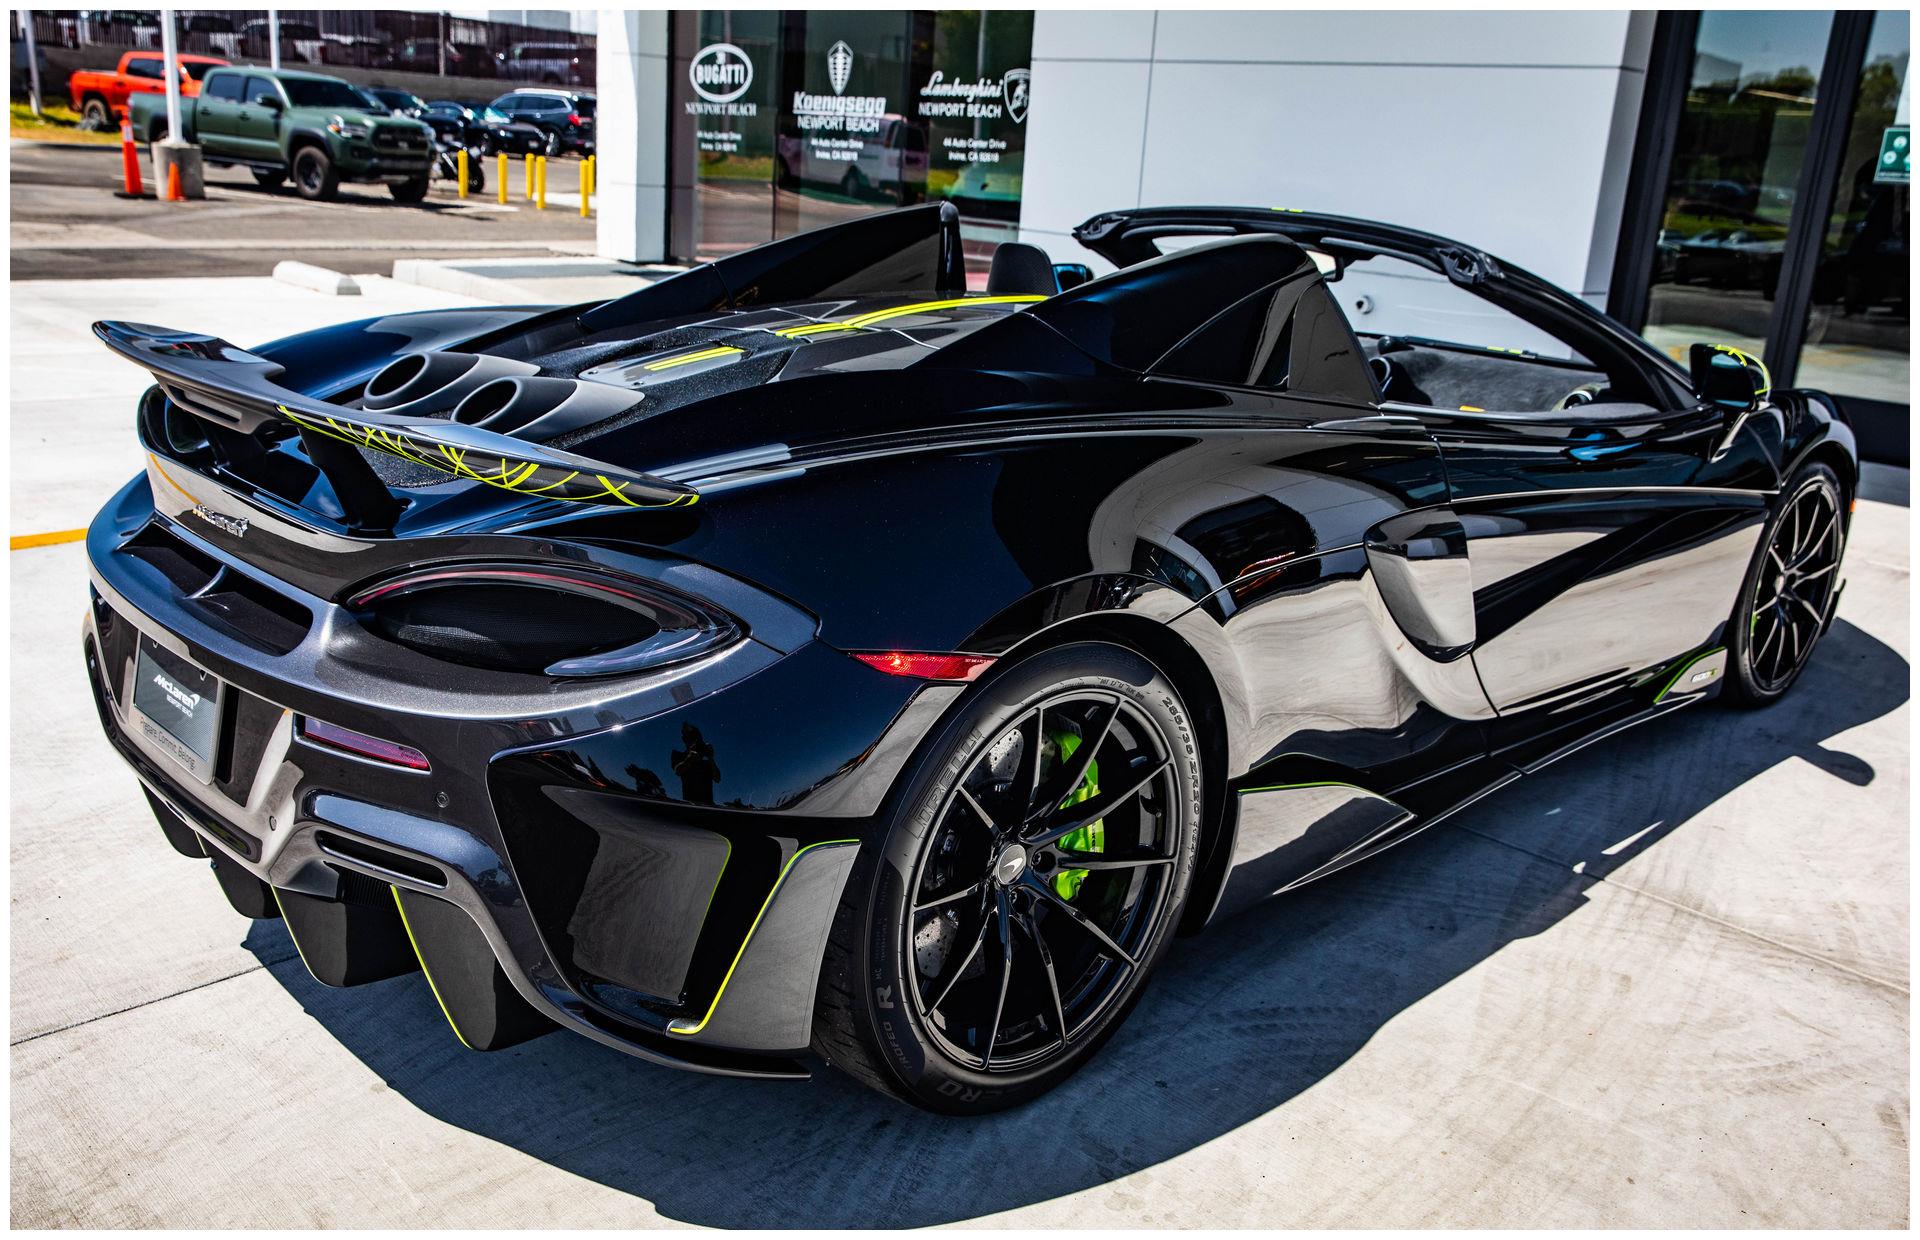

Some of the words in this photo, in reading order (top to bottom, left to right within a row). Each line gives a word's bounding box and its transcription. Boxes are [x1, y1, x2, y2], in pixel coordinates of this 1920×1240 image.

[696, 64, 745, 84] BUGATTI
[920, 71, 1004, 102] Lamborghini
[685, 102, 727, 115] NEWPORT
[728, 103, 757, 116] BEACH
[793, 91, 886, 118] Koenigsegg
[918, 102, 966, 117] NEWPORT
[967, 103, 1002, 118] BEACH
[797, 115, 845, 130] NEWPORT
[845, 117, 880, 132] BEACH
[953, 137, 967, 148] Auto
[967, 138, 988, 149] Center
[988, 138, 1007, 150] Drive
[967, 151, 978, 161] CA
[192, 504, 246, 538] McLaren
[153, 674, 196, 710] McLaren
[1162, 696, 1194, 755] 285/35
[1189, 760, 1200, 815] ZR20
[903, 720, 982, 839] PIRELLI
[876, 984, 894, 1009] R
[884, 1021, 913, 1073] TROFEO
